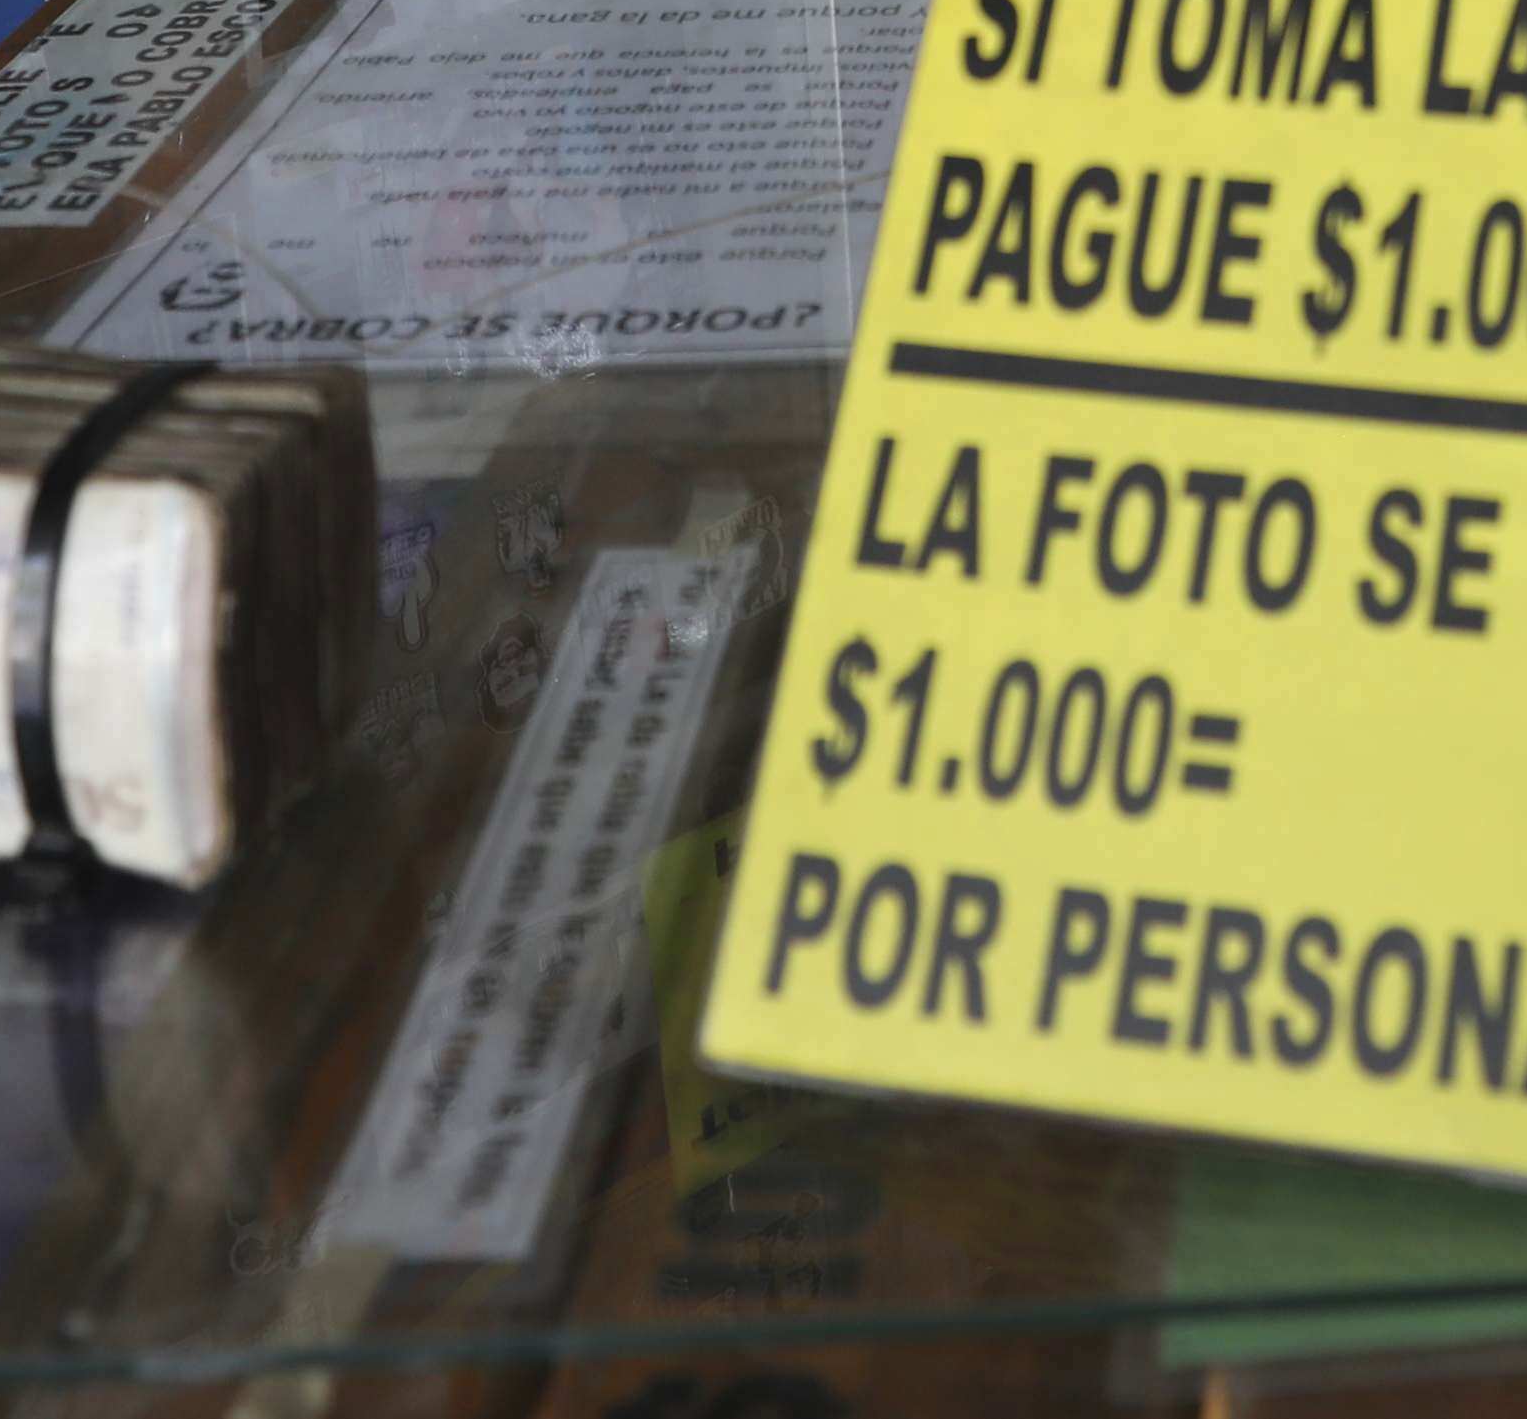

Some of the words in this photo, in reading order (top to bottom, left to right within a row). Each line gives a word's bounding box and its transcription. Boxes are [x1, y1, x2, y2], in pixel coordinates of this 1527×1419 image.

[447, 310, 511, 343] SE
[526, 302, 823, 338] ¿PORQUE
[909, 153, 1273, 329] PAGUE
[187, 313, 422, 347] COBRA?
[851, 434, 981, 584] LA
[1024, 453, 1315, 619] FOTO
[1357, 485, 1501, 635] SE
[808, 636, 1244, 818] $1.000=
[762, 850, 1003, 1026] POR
